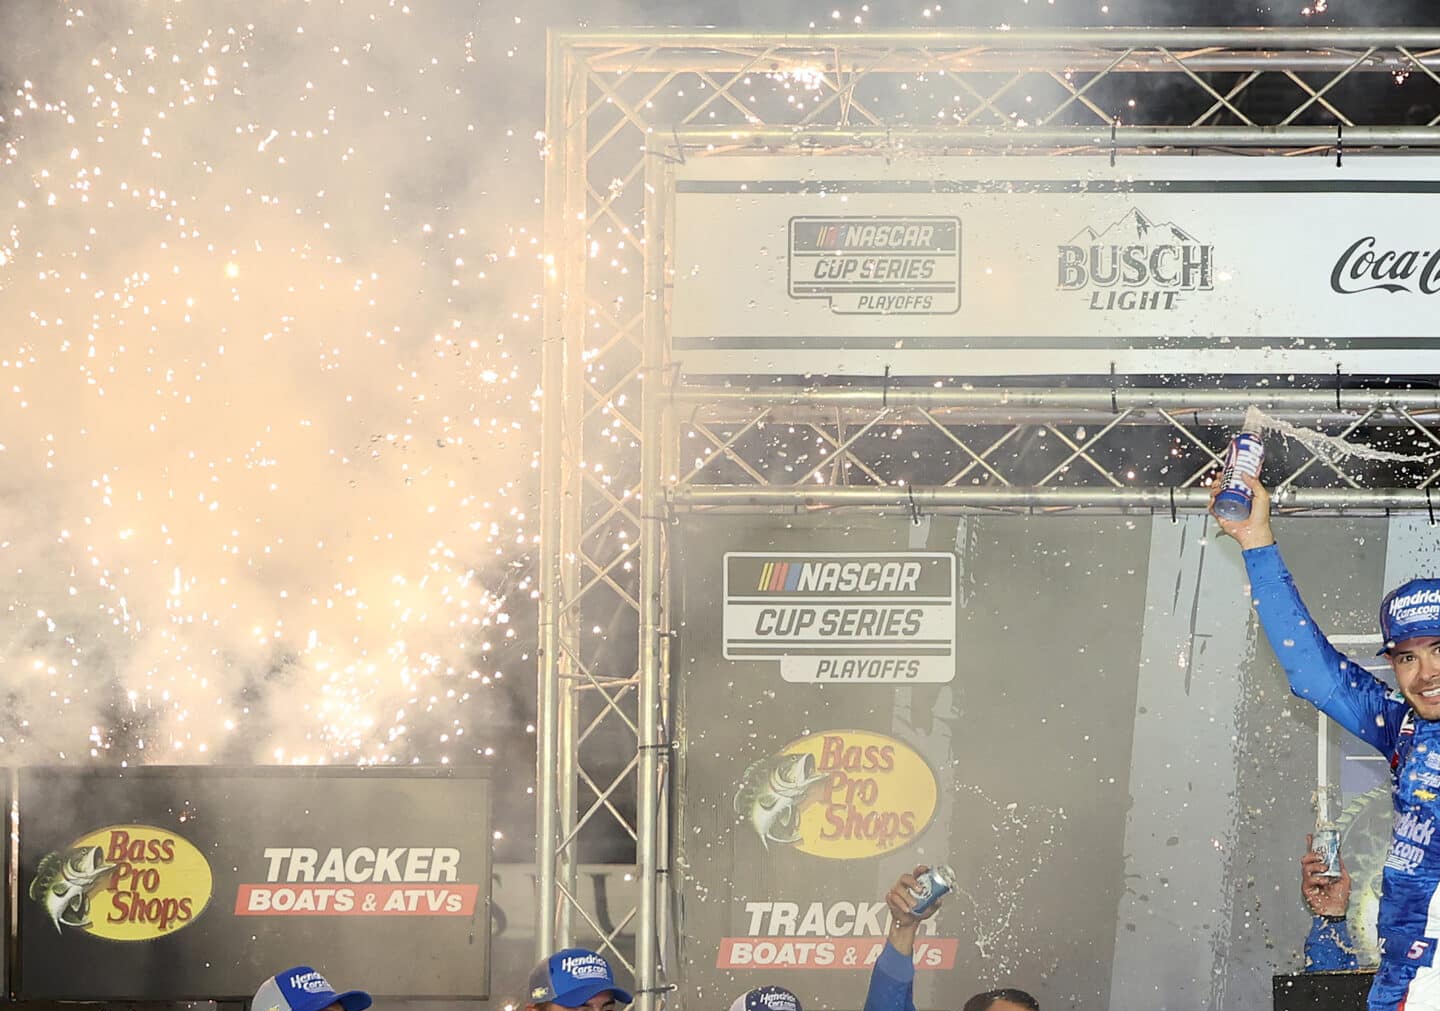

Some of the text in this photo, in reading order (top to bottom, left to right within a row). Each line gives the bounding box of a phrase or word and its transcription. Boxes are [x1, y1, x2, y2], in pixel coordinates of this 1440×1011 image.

[841, 225, 934, 249] NASCAR
[813, 258, 936, 280] CUP SERIES
[1057, 243, 1215, 291] BUSCH
[856, 294, 933, 311] PLAYOFFS
[1087, 291, 1181, 312] LIGHT
[797, 562, 923, 592] NASCAR
[754, 608, 924, 637] CUP SERIES
[1395, 604, 1440, 620] Cars.com
[815, 659, 921, 679] PLAYOFFS
[817, 735, 896, 773] Bass
[824, 770, 879, 807] Pro
[820, 803, 917, 848] Shops
[106, 830, 175, 863] Bass
[106, 862, 161, 893] Pro
[263, 847, 461, 883] TRACKER
[107, 890, 193, 931] Shops
[247, 888, 463, 912] BOATS & ATVs
[744, 902, 940, 937] TRACKR
[729, 942, 836, 966] BOATS
[842, 947, 858, 966] &
[1407, 941, 1429, 961] 5
